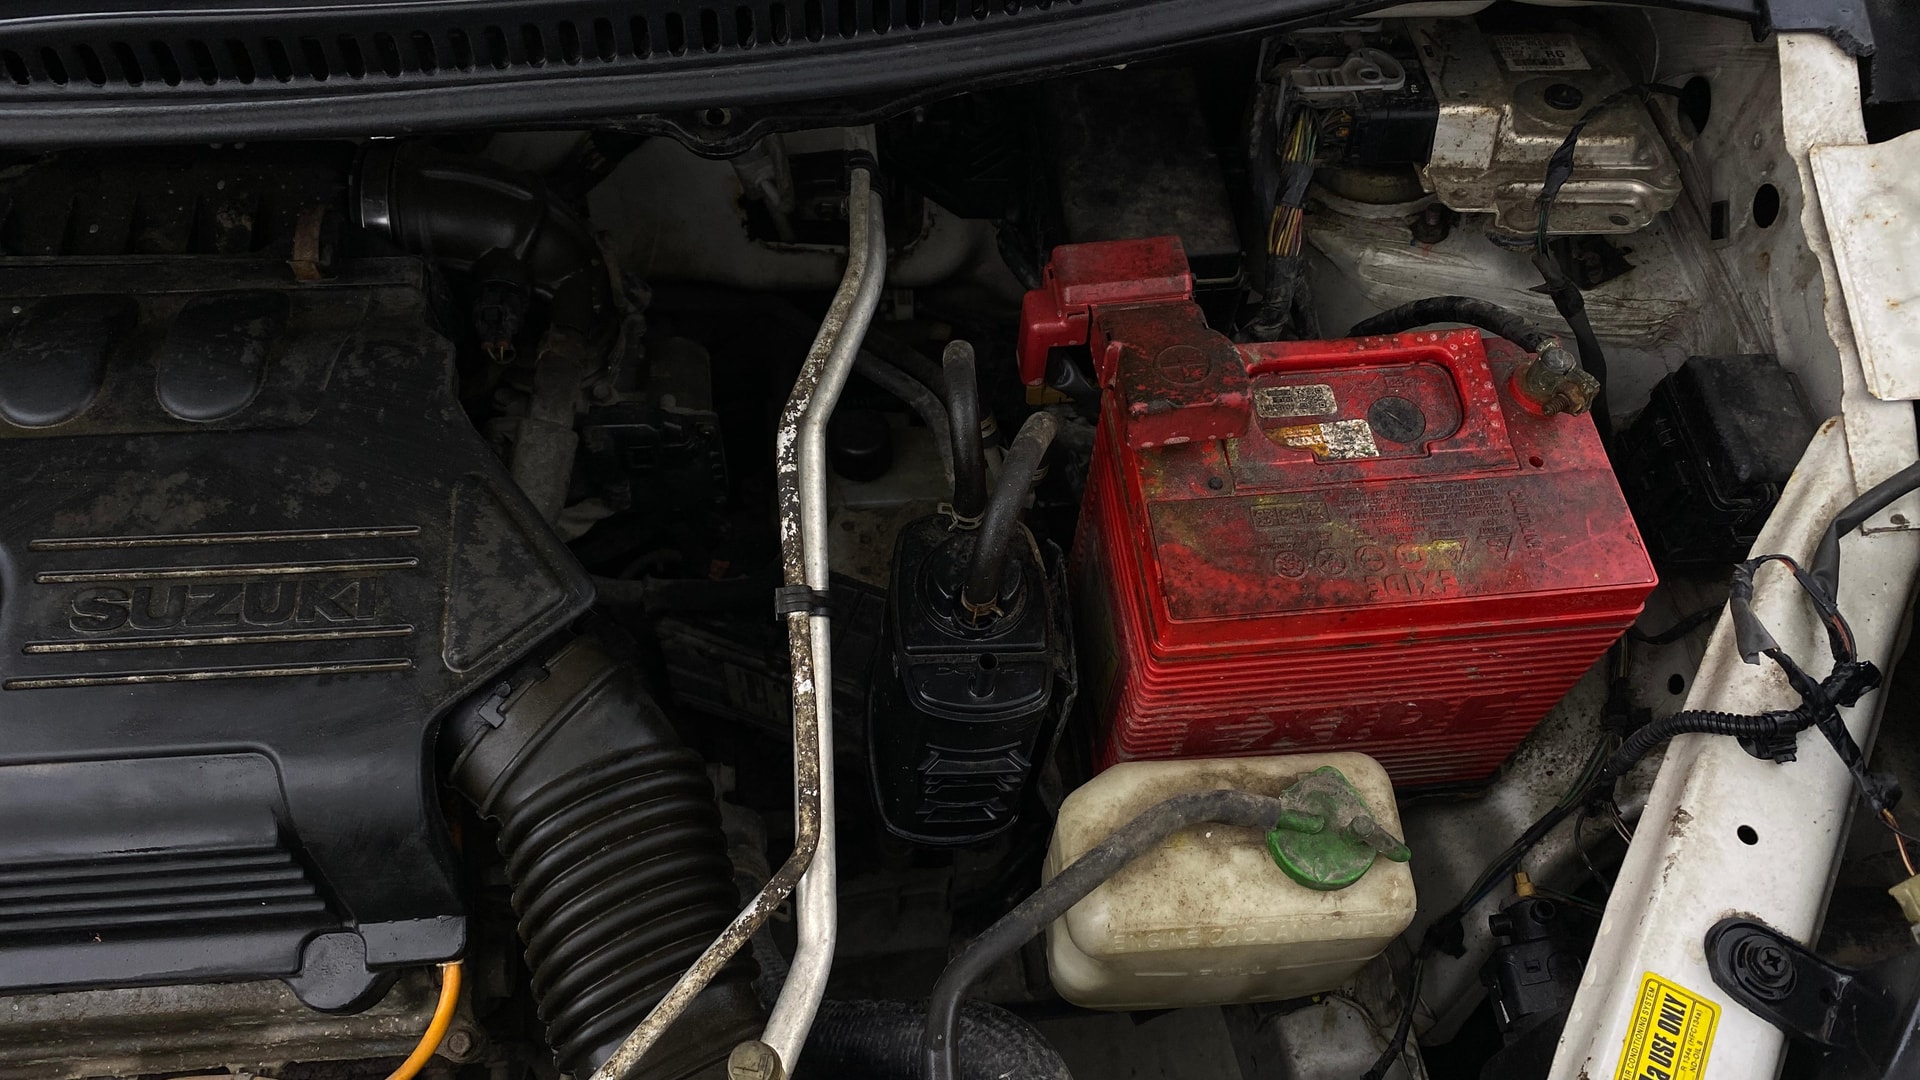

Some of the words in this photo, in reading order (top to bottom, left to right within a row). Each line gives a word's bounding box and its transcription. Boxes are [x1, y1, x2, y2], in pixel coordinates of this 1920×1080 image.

[69, 577, 378, 633] SUZUKI
[1364, 569, 1460, 601] EXIDE
[1114, 931, 1200, 950] ENGINE
[1627, 1016, 1648, 1069] CONDITIONING
[1642, 986, 1655, 1016] SYSTEM
[1657, 993, 1687, 1036] ONLY
[1648, 1032, 1677, 1069] USE
[1683, 1047, 1692, 1064] 134a
[1688, 1009, 1703, 1047] (HFC134a)
[1690, 1048, 1702, 1072] ND-OIL
